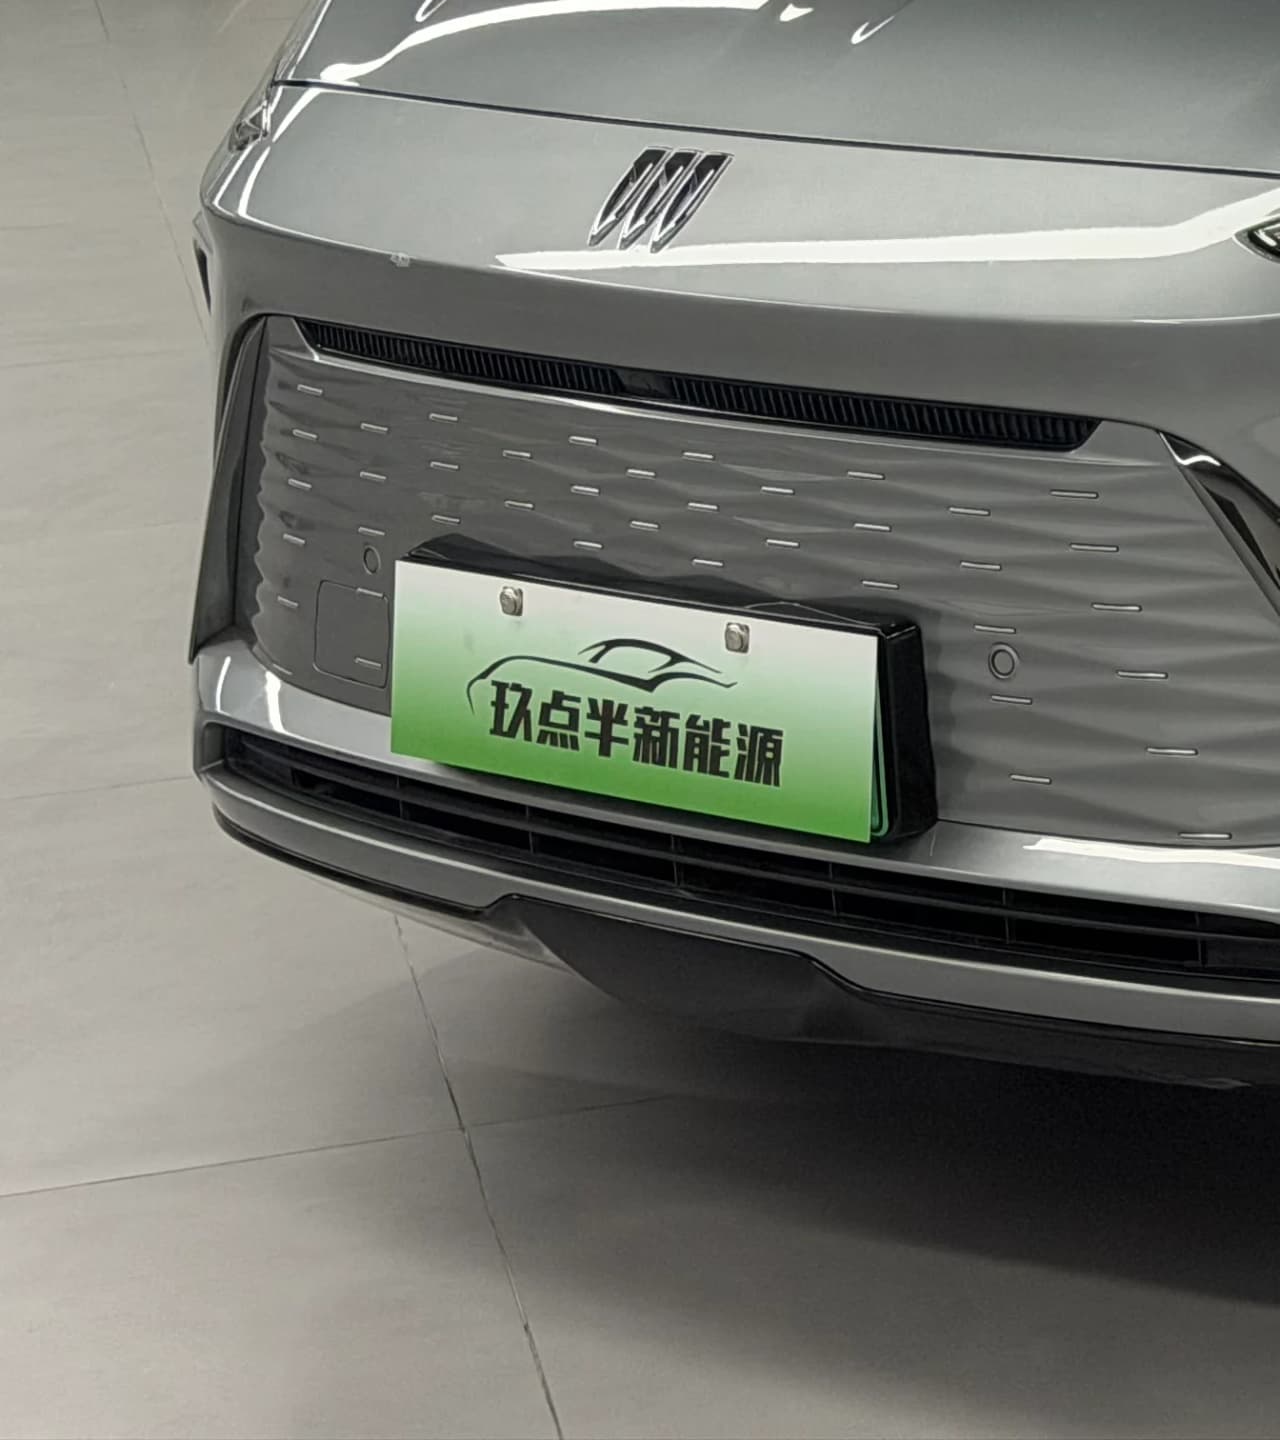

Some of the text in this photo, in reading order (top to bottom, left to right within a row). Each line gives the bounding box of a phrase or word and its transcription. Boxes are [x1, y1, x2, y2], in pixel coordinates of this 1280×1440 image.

[489, 679, 784, 788] 玖点半新能源
